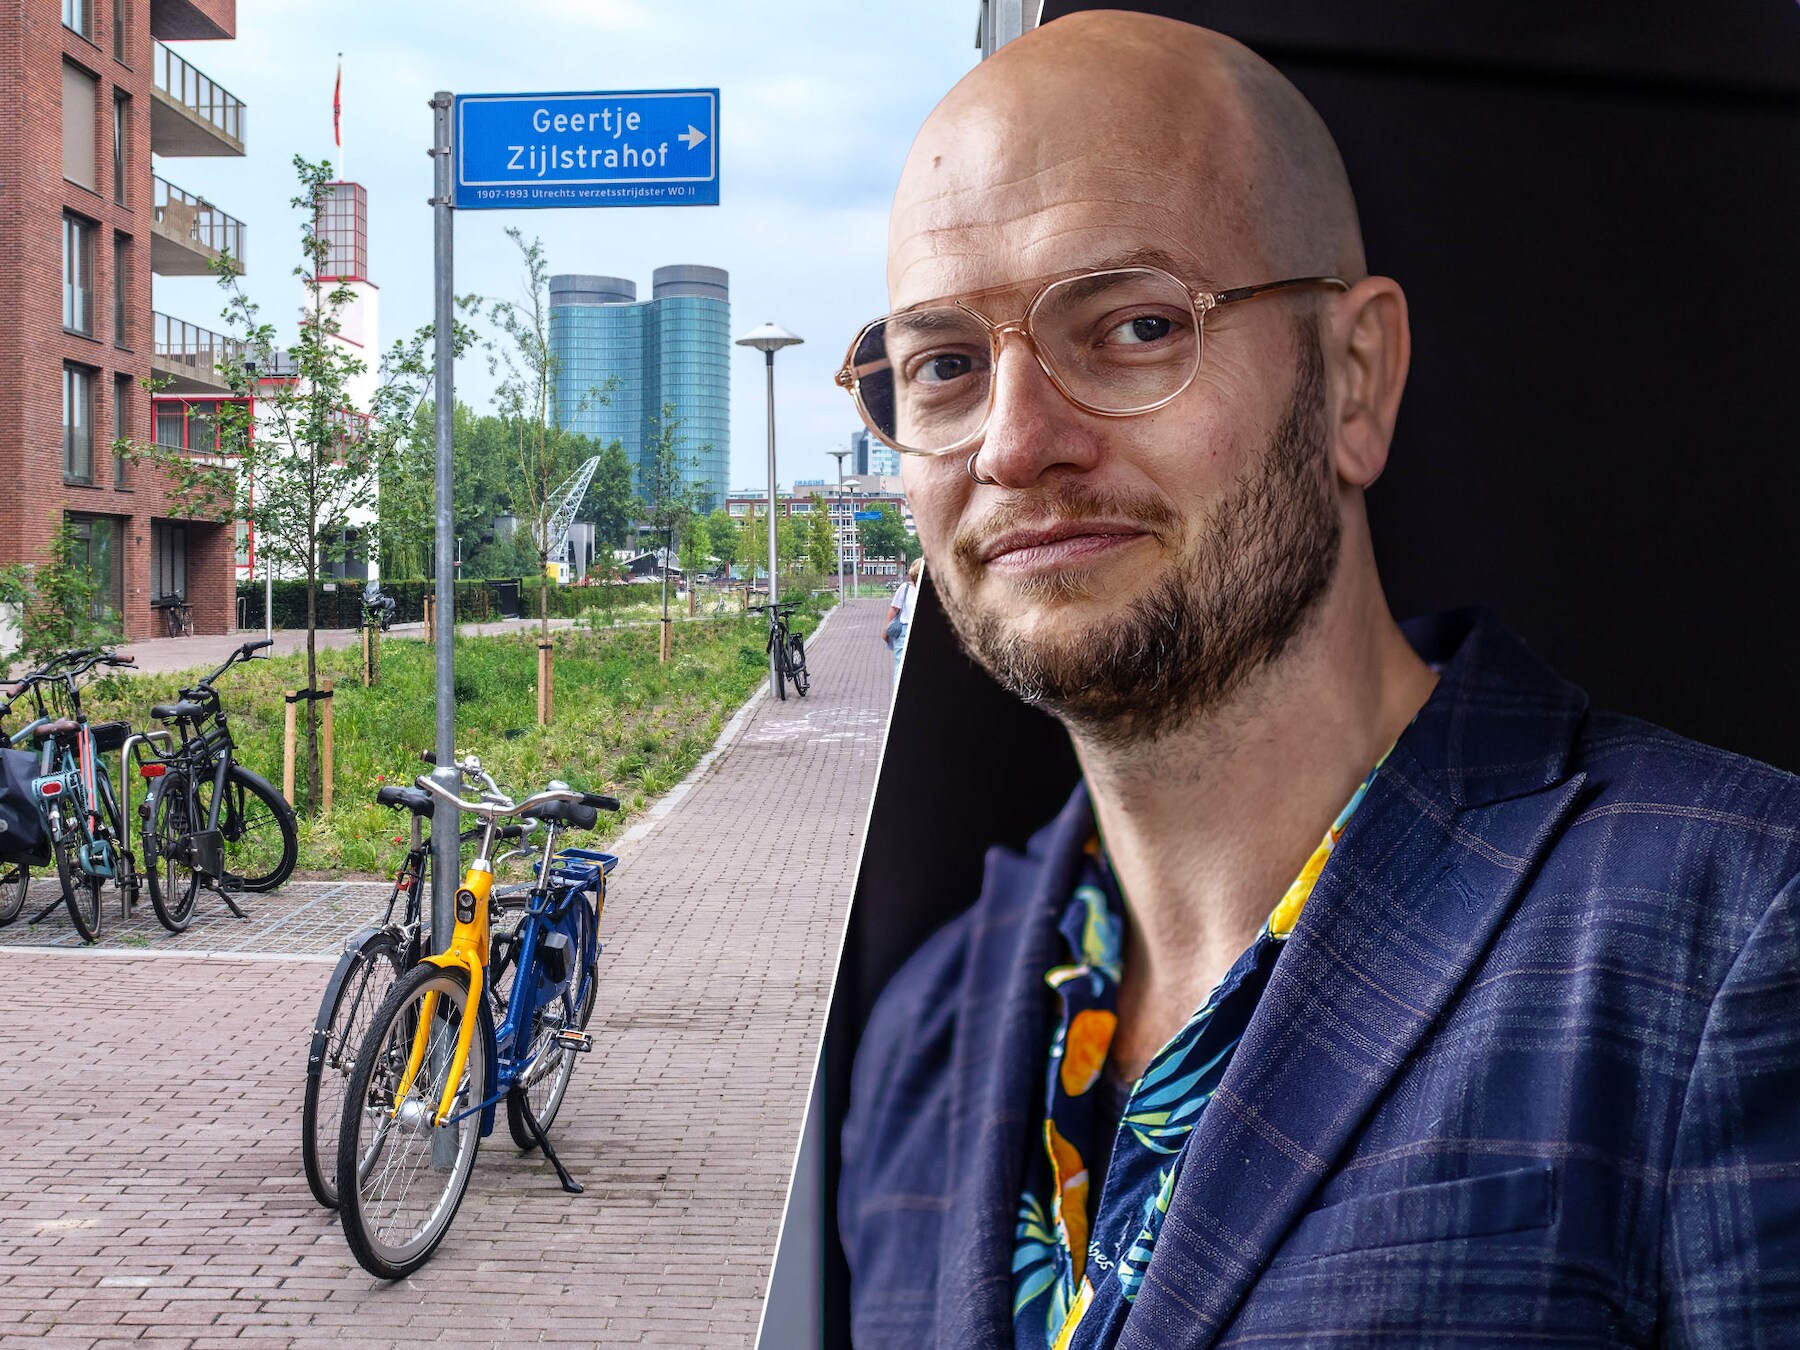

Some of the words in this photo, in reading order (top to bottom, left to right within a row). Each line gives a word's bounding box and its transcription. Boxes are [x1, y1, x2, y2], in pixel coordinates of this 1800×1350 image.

[533, 107, 641, 139] Geertje
[507, 142, 668, 177] Zijlstrahof
[476, 189, 529, 199] 1907-1993
[532, 188, 576, 198] Utrechts
[579, 187, 665, 198] verzetsstrijdster
[668, 186, 685, 196] WO
[1088, 1240, 1115, 1270] bes
